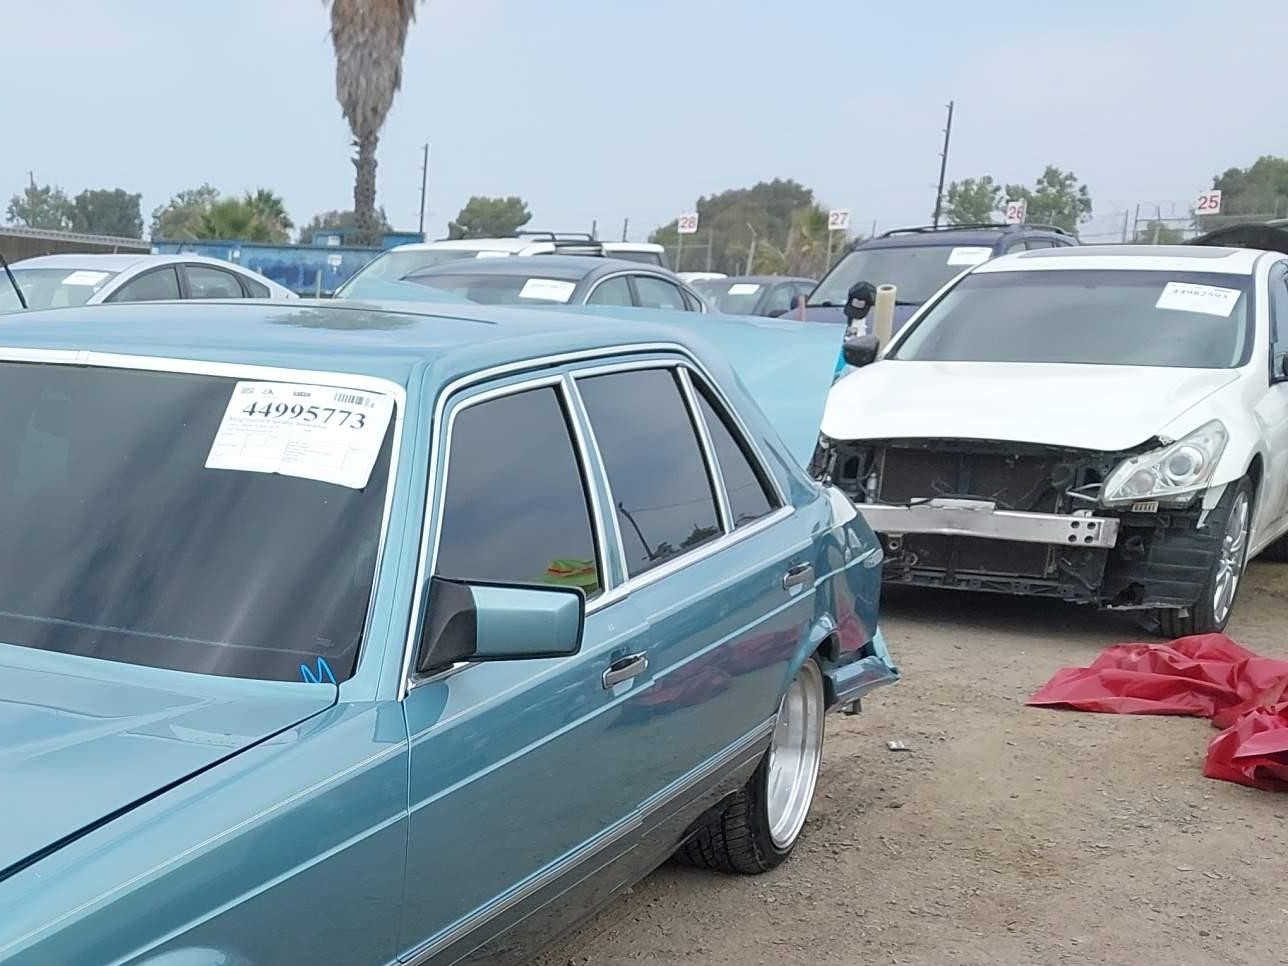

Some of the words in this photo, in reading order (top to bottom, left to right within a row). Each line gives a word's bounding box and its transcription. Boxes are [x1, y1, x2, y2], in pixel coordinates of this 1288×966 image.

[1198, 194, 1219, 210] 25
[680, 216, 697, 230] 28
[831, 212, 848, 226] 27
[242, 400, 367, 430] 44995773
